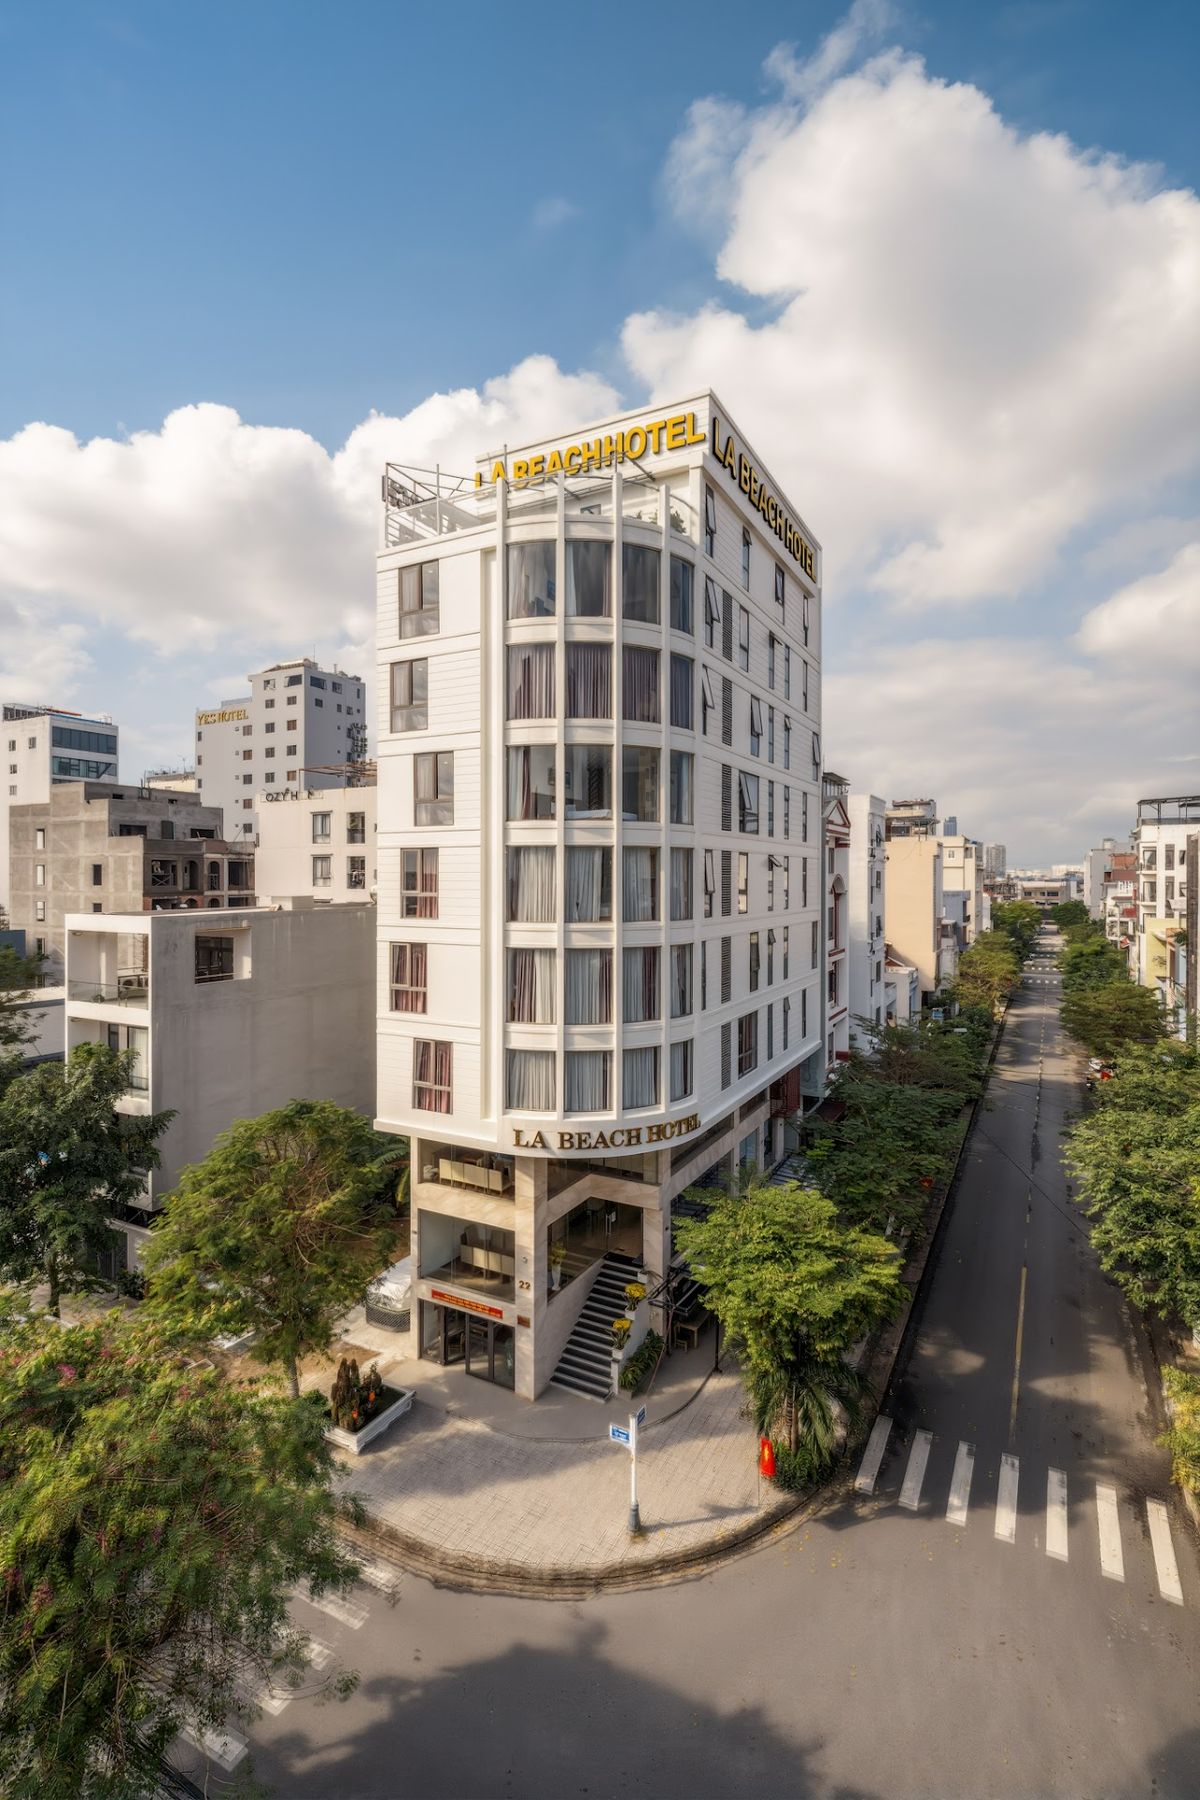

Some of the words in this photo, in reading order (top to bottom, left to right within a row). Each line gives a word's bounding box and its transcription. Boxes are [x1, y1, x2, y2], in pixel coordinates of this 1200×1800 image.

[513, 438, 602, 488] BEACH
[604, 412, 705, 464] HOTEL
[712, 417, 737, 480] LA
[739, 453, 783, 540] BEACH
[785, 518, 816, 583] HOTEL
[198, 714, 217, 725] YES
[218, 709, 249, 722] HOTEL
[513, 1129, 548, 1149] LA
[557, 1128, 643, 1150] BEACH
[646, 1113, 701, 1143] HOTEL
[519, 1281, 530, 1290] 22
